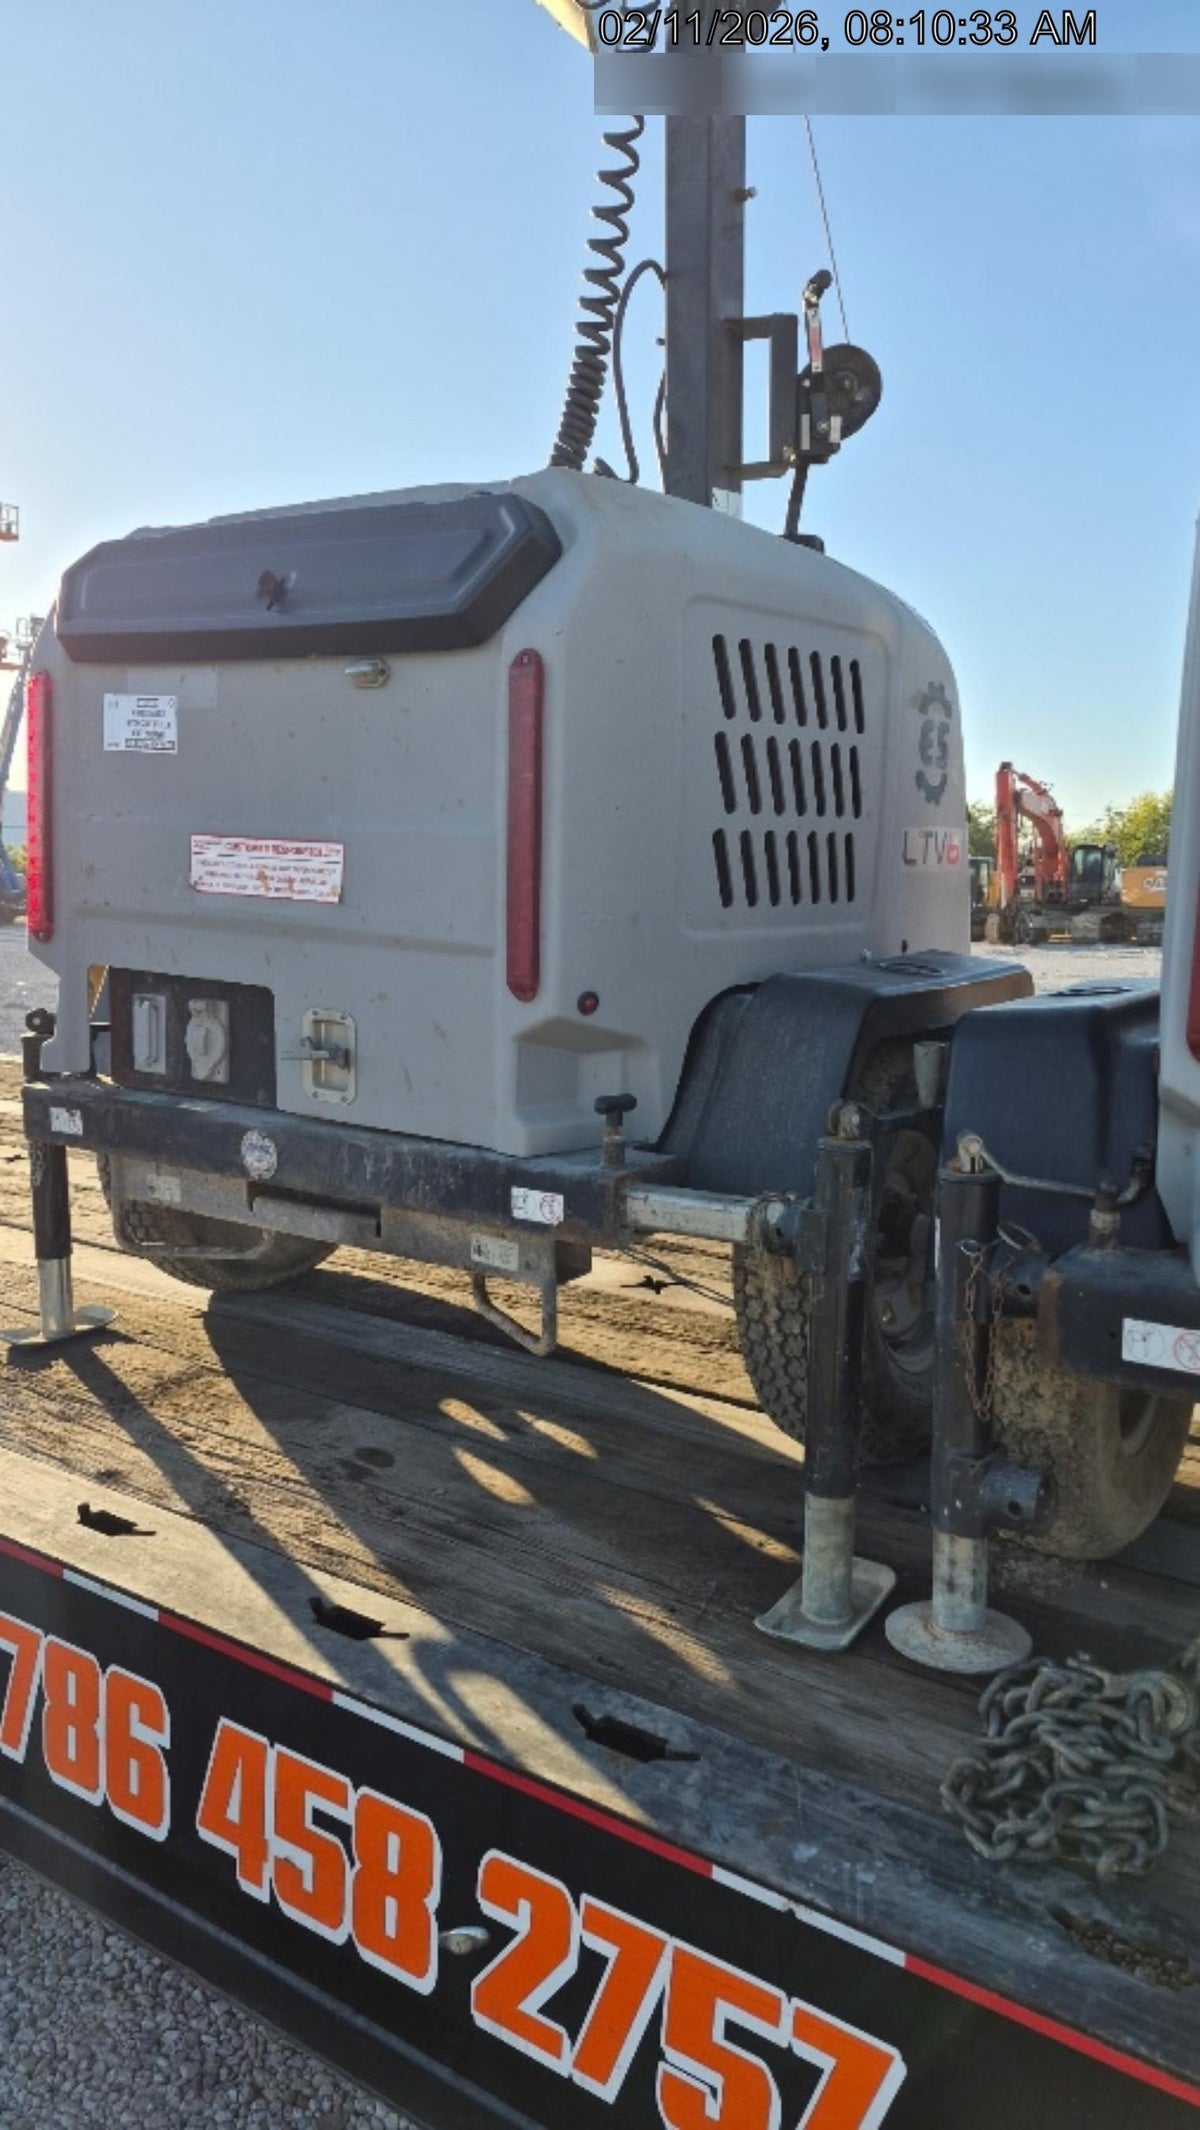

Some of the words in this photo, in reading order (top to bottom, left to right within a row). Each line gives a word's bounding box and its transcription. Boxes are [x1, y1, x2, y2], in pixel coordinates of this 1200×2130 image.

[0, 1610, 170, 1842] 786
[196, 1716, 442, 1996] 458
[470, 1848, 907, 2130] 2757
